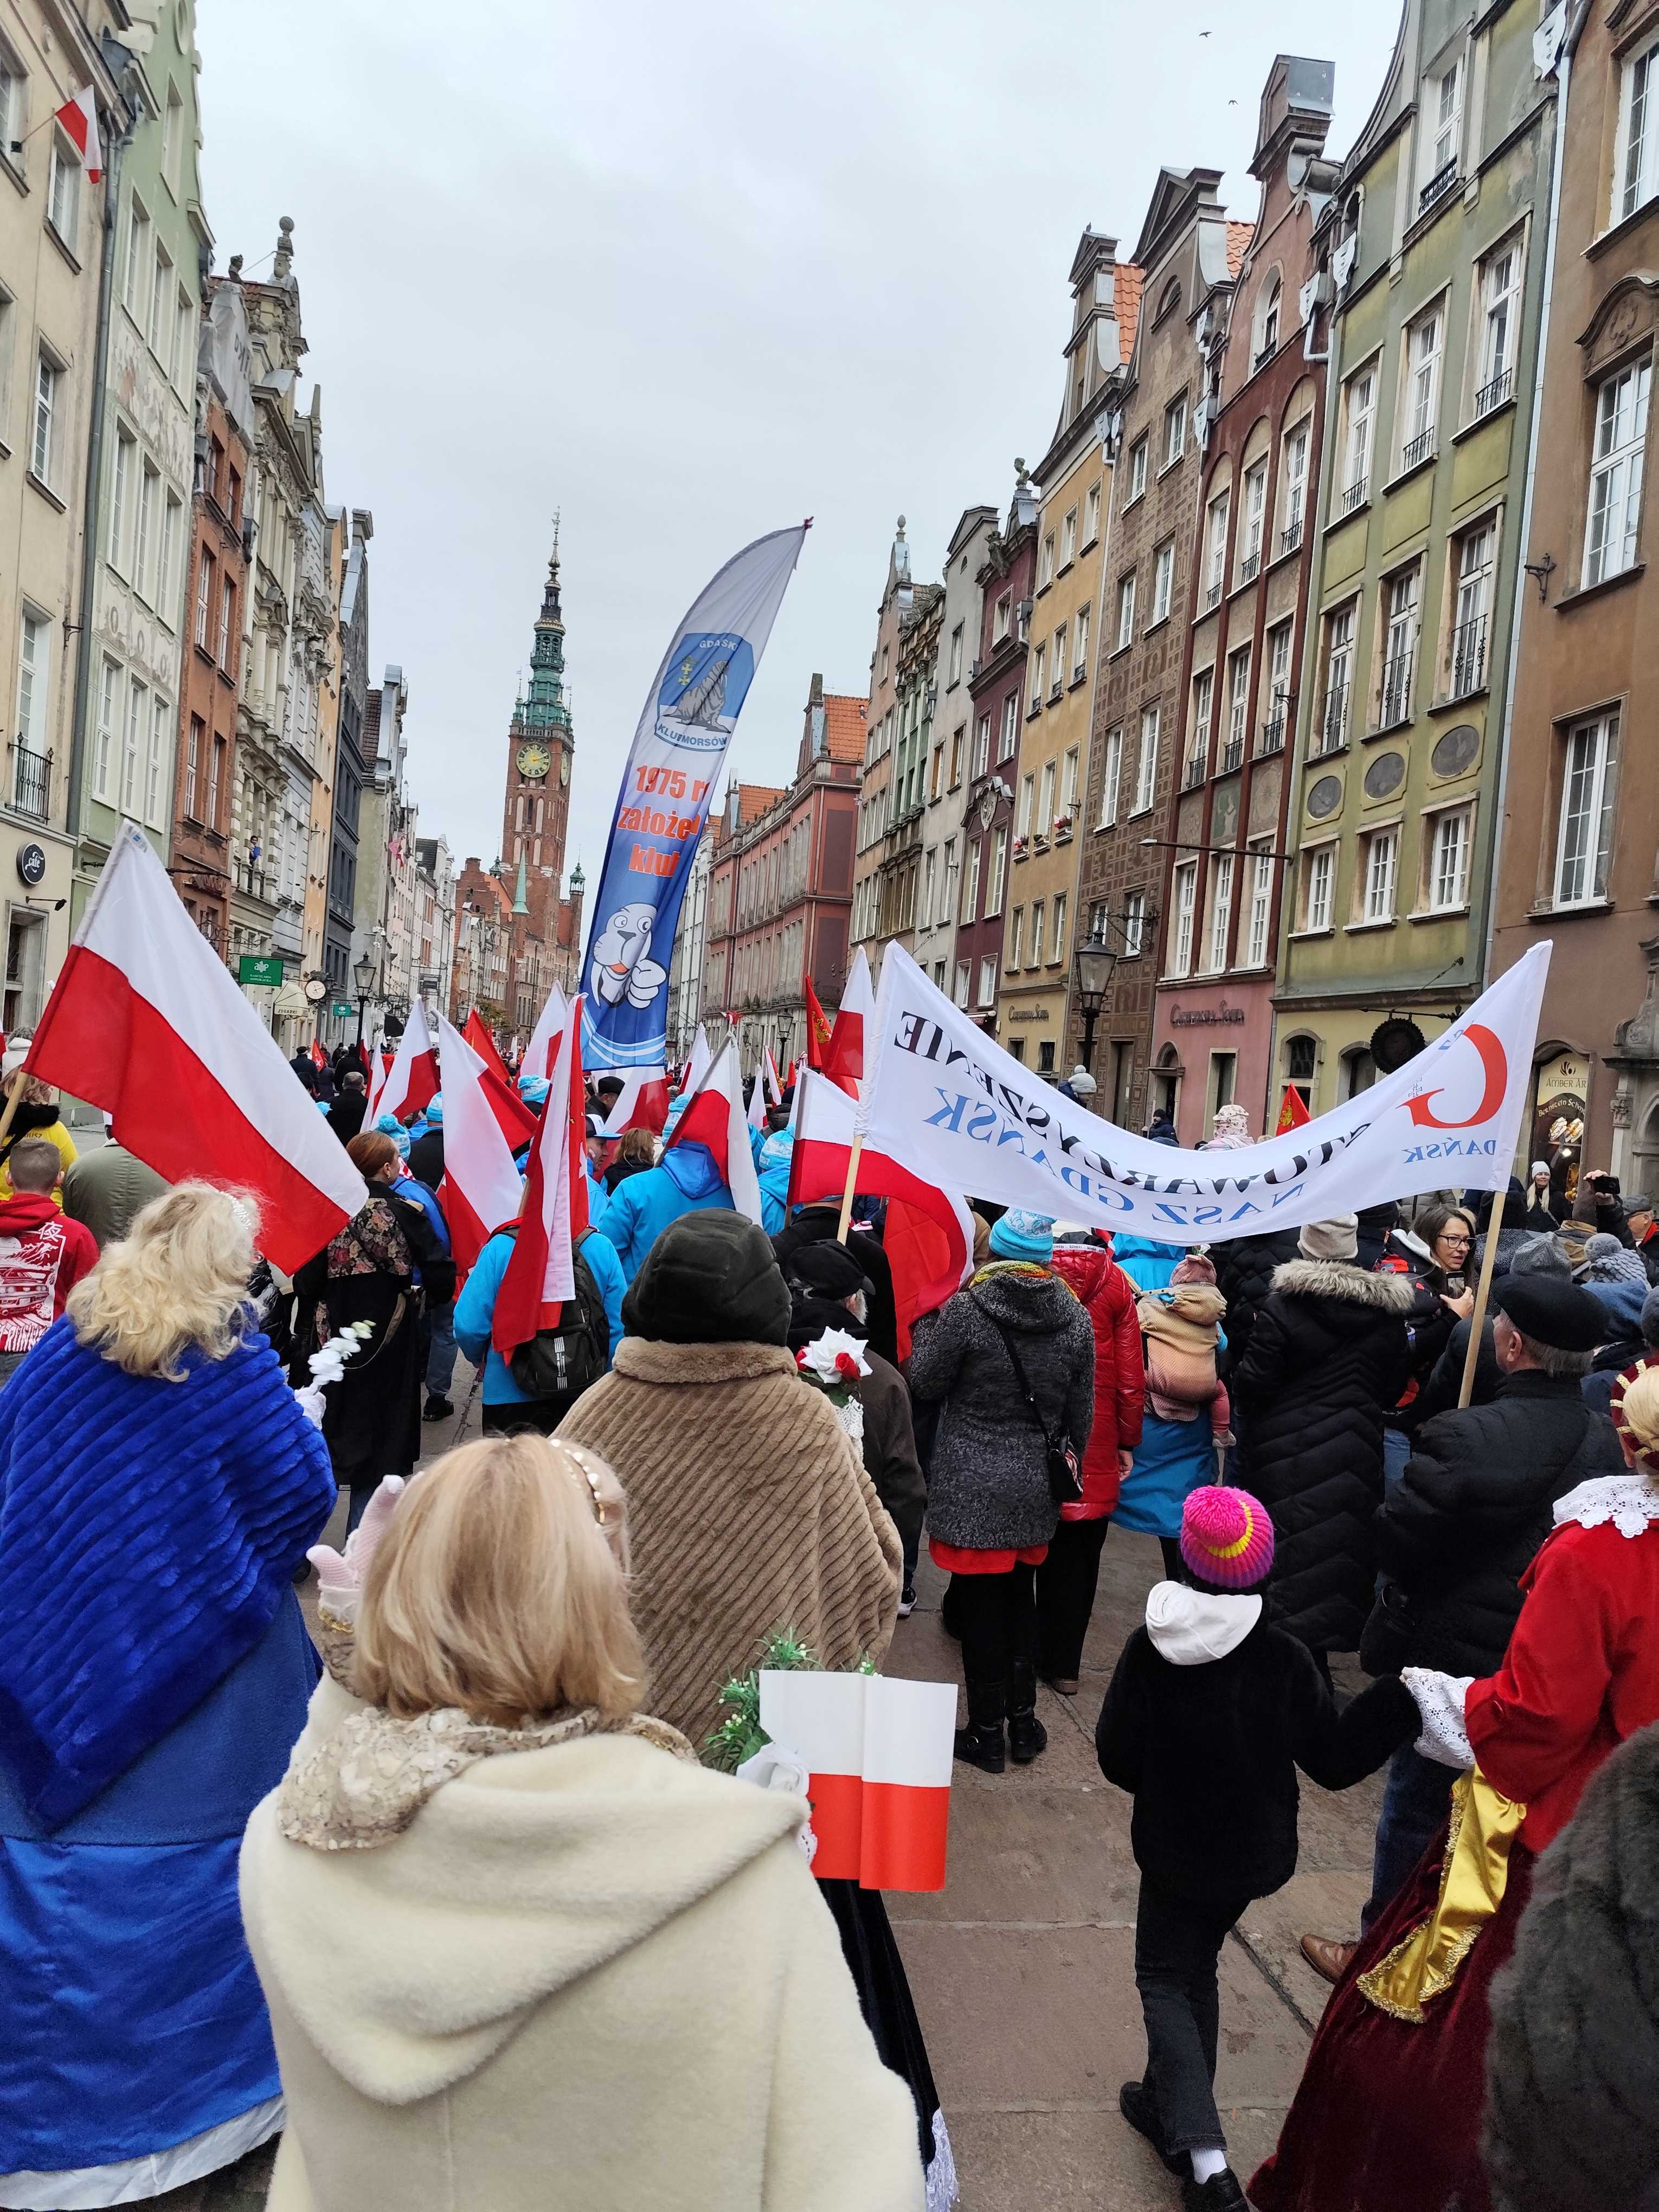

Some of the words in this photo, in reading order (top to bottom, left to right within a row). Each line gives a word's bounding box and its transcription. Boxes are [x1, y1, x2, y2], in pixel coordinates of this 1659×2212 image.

[681, 735, 728, 747] MORSÓW
[636, 765, 687, 799] 1975
[1546, 1077, 1573, 1088] AMBER
[1576, 1078, 1588, 1089] AR
